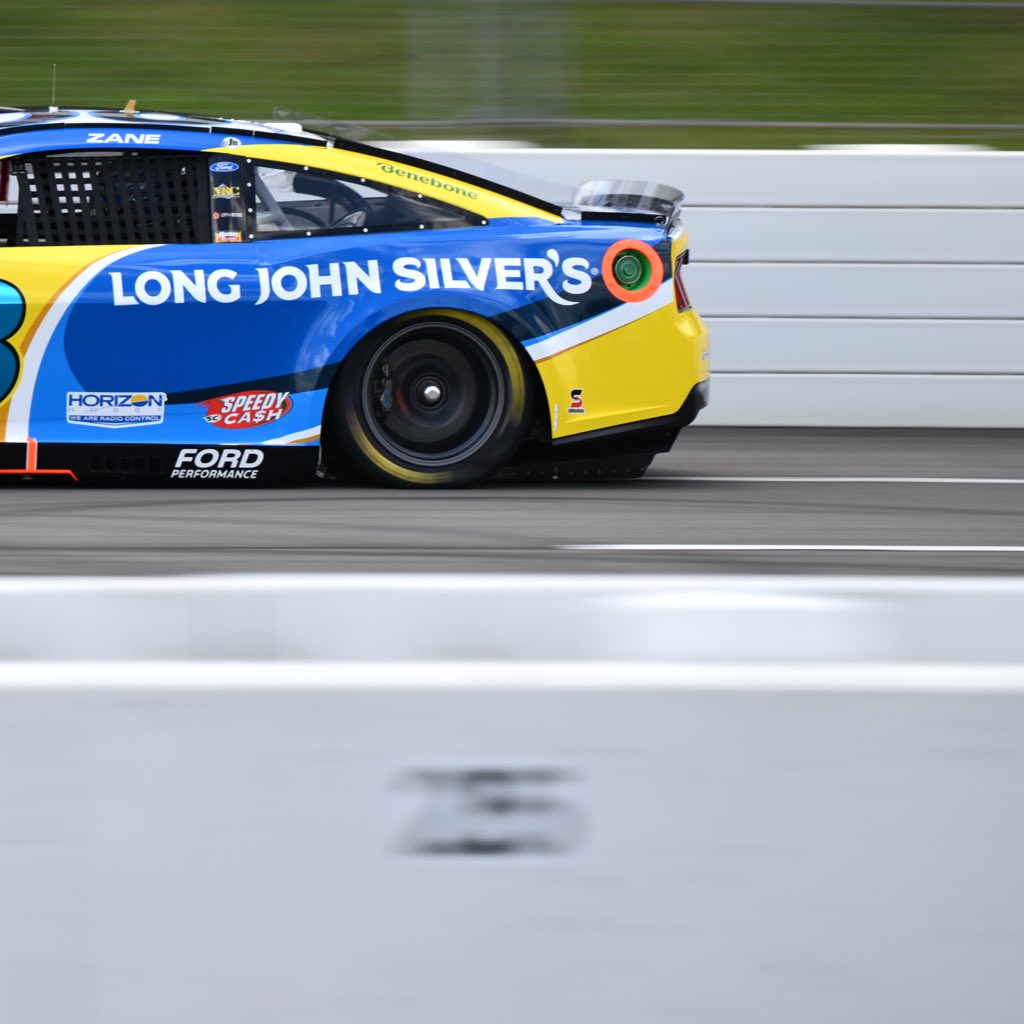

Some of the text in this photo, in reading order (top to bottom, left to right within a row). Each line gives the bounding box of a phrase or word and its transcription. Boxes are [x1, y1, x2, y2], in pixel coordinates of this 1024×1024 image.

[86, 132, 162, 144] ZANE
[376, 162, 479, 199] Benebone
[109, 249, 593, 307] LONG JOHN SILVER'S
[68, 394, 162, 407] HORIZON
[219, 392, 290, 413] SPEEDY
[223, 409, 283, 425] CA$H
[174, 448, 264, 469] FORD
[170, 469, 259, 479] PERFORMANCE
